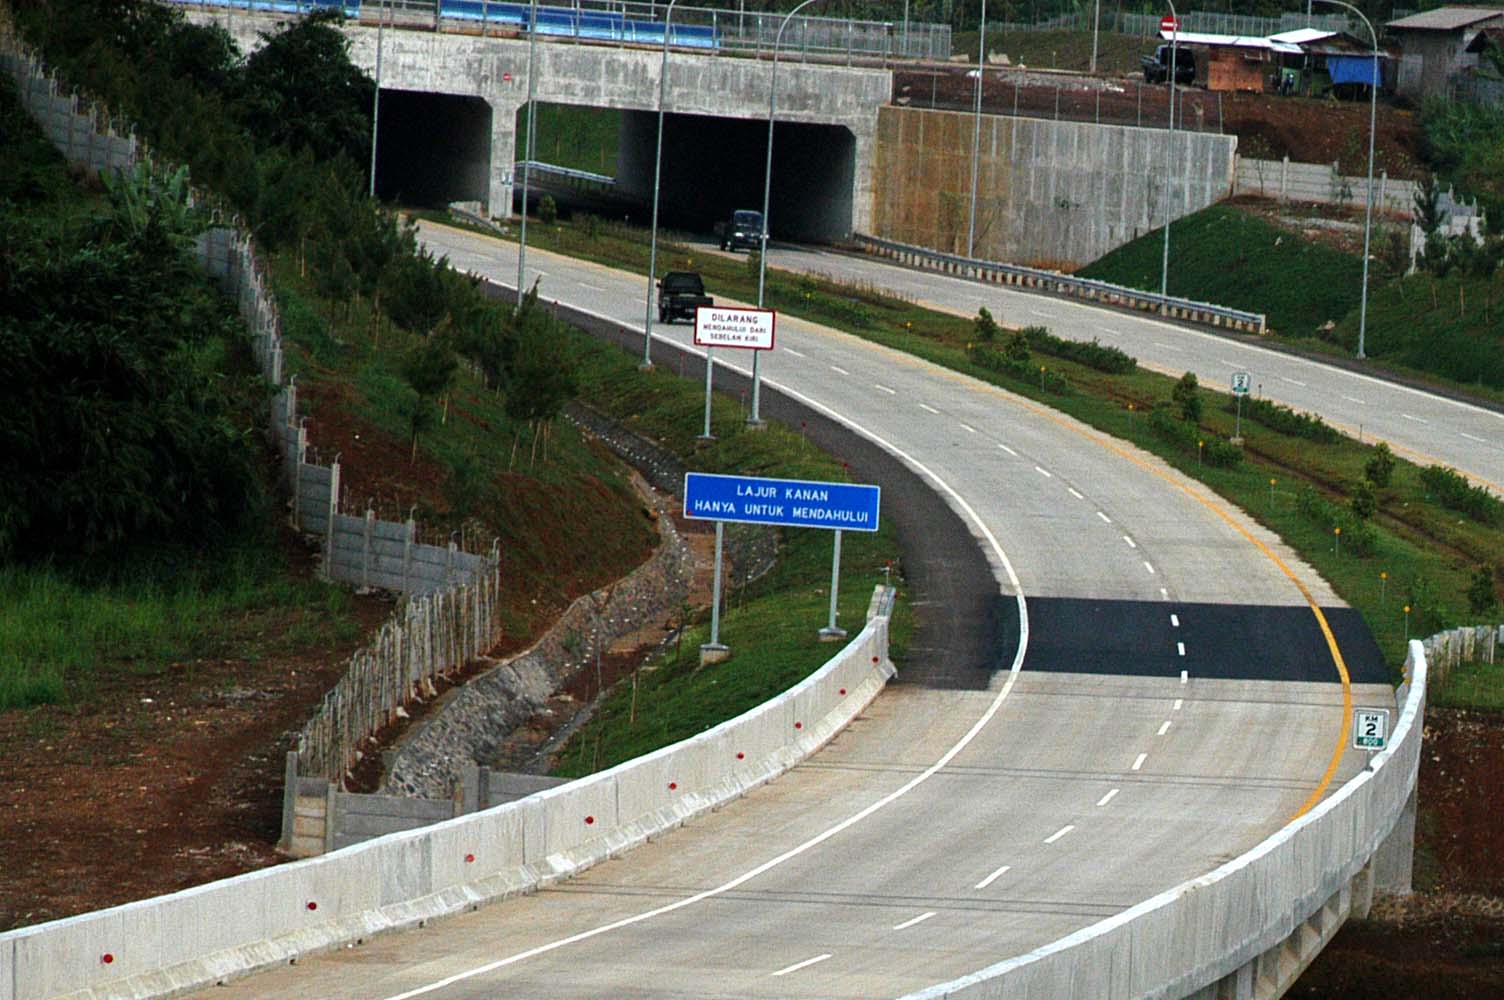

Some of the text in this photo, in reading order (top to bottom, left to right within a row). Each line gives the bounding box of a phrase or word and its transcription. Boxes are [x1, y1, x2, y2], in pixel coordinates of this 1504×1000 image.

[711, 313, 758, 324] DILARANG
[736, 484, 829, 502] LAJUR KANAN
[694, 500, 869, 523] HANYA UNTUK MENDAHULUI
[1365, 722, 1377, 736] 2
